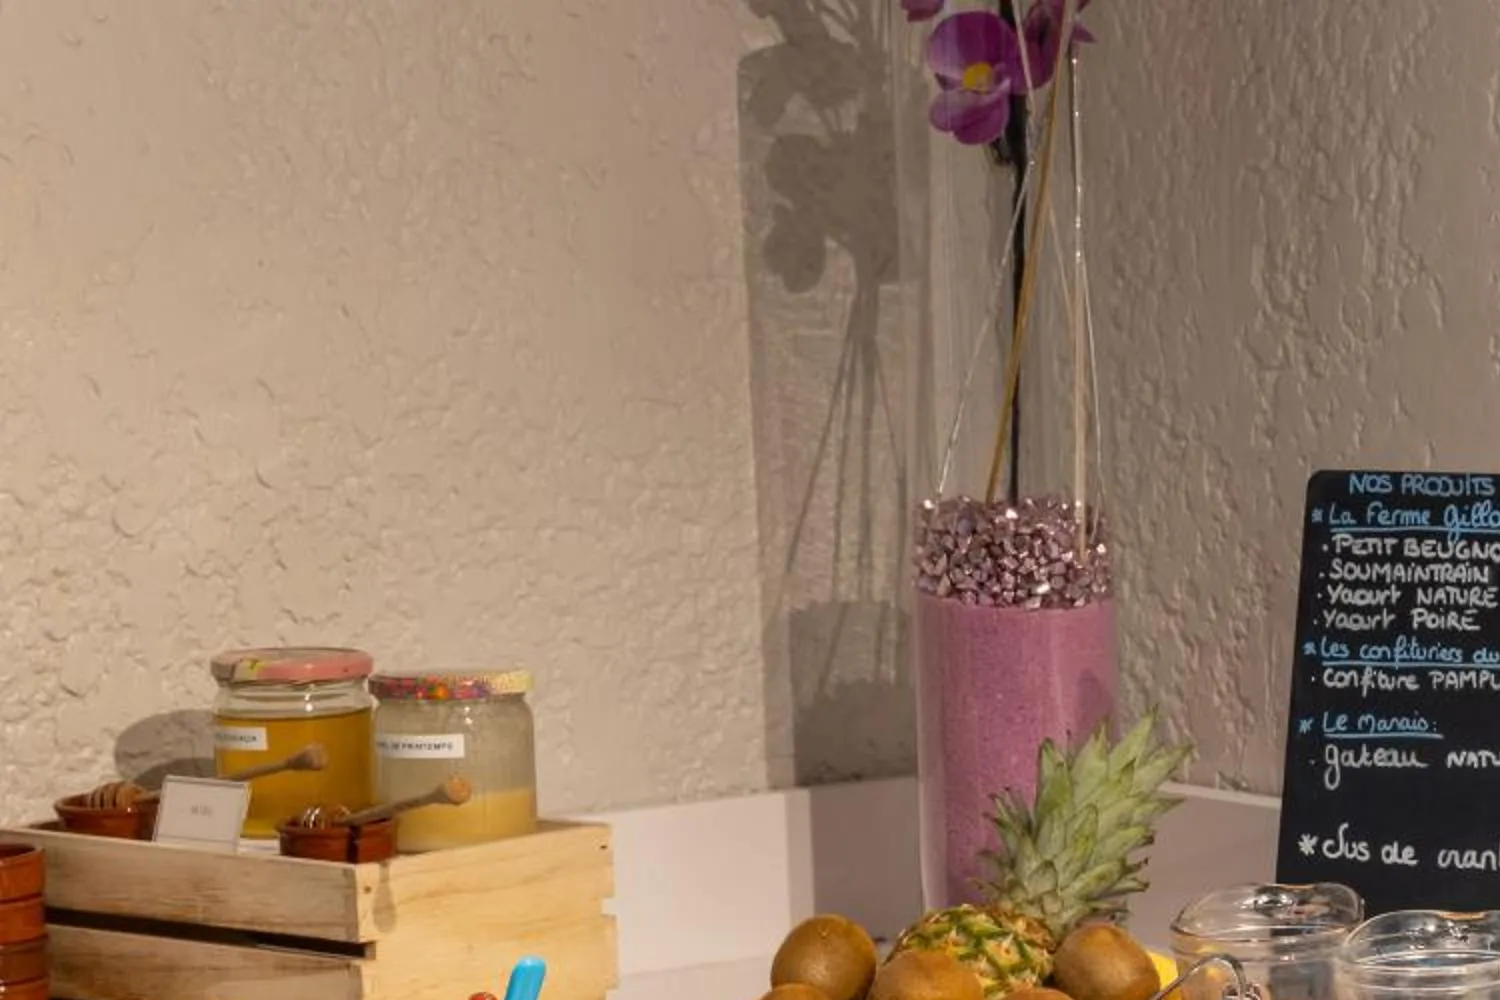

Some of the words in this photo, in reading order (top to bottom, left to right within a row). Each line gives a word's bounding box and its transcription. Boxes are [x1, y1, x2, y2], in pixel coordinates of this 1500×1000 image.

[1350, 473, 1393, 494] NOS
[1329, 502, 1356, 525] La
[1327, 583, 1402, 604] Yaourt
[1416, 586, 1499, 608] NATURE
[1322, 608, 1396, 630] Yaourt
[1473, 647, 1500, 664] du
[1323, 711, 1349, 733] Le
[1322, 822, 1371, 862] Jus
[1381, 840, 1419, 867] de
